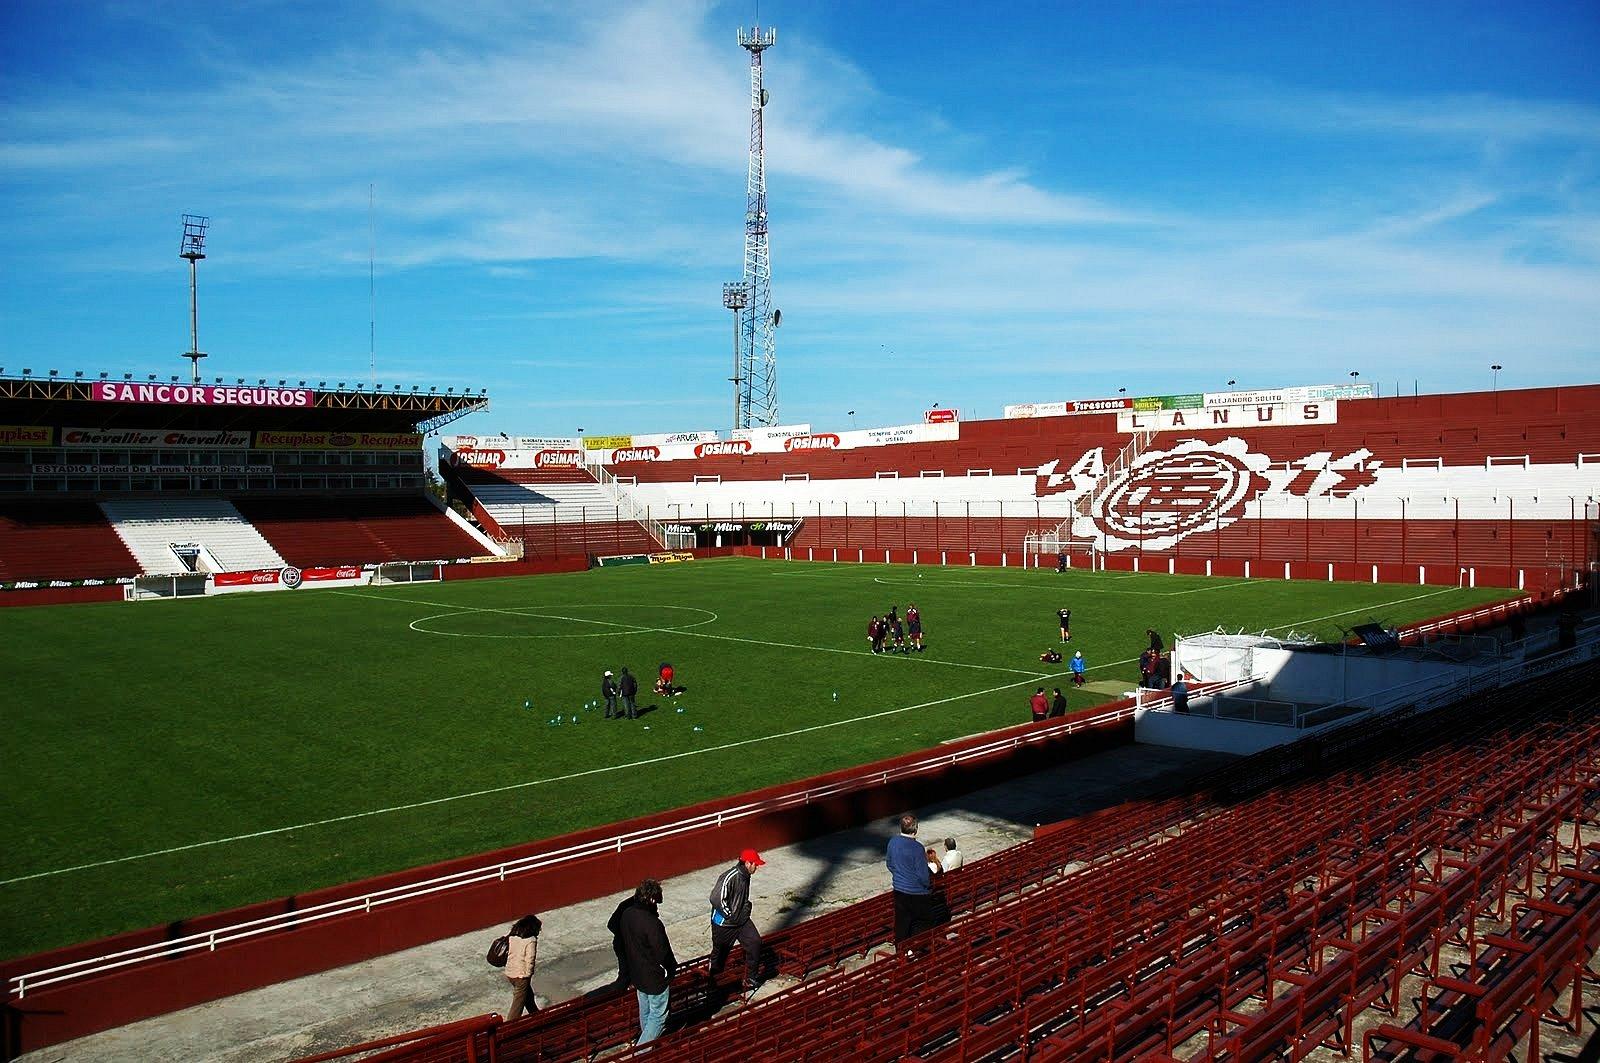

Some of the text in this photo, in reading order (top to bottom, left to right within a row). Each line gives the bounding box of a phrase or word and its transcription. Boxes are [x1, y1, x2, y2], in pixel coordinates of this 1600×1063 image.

[102, 384, 307, 406] SANCOR SEGUROS
[1072, 400, 1126, 413] Firestone
[65, 430, 248, 446] Chevallier Chevallier
[260, 432, 326, 447] Recuplast
[360, 434, 420, 448] Recuplast
[788, 435, 835, 450] JOSIMAR
[698, 440, 747, 457] JOSIMAR
[614, 449, 655, 465] JOSIMAR
[35, 465, 87, 474] ESTADIO
[91, 465, 128, 474] Ciudad
[667, 521, 793, 534] Mitre Mitre Mitre
[15, 581, 39, 589] Mitre
